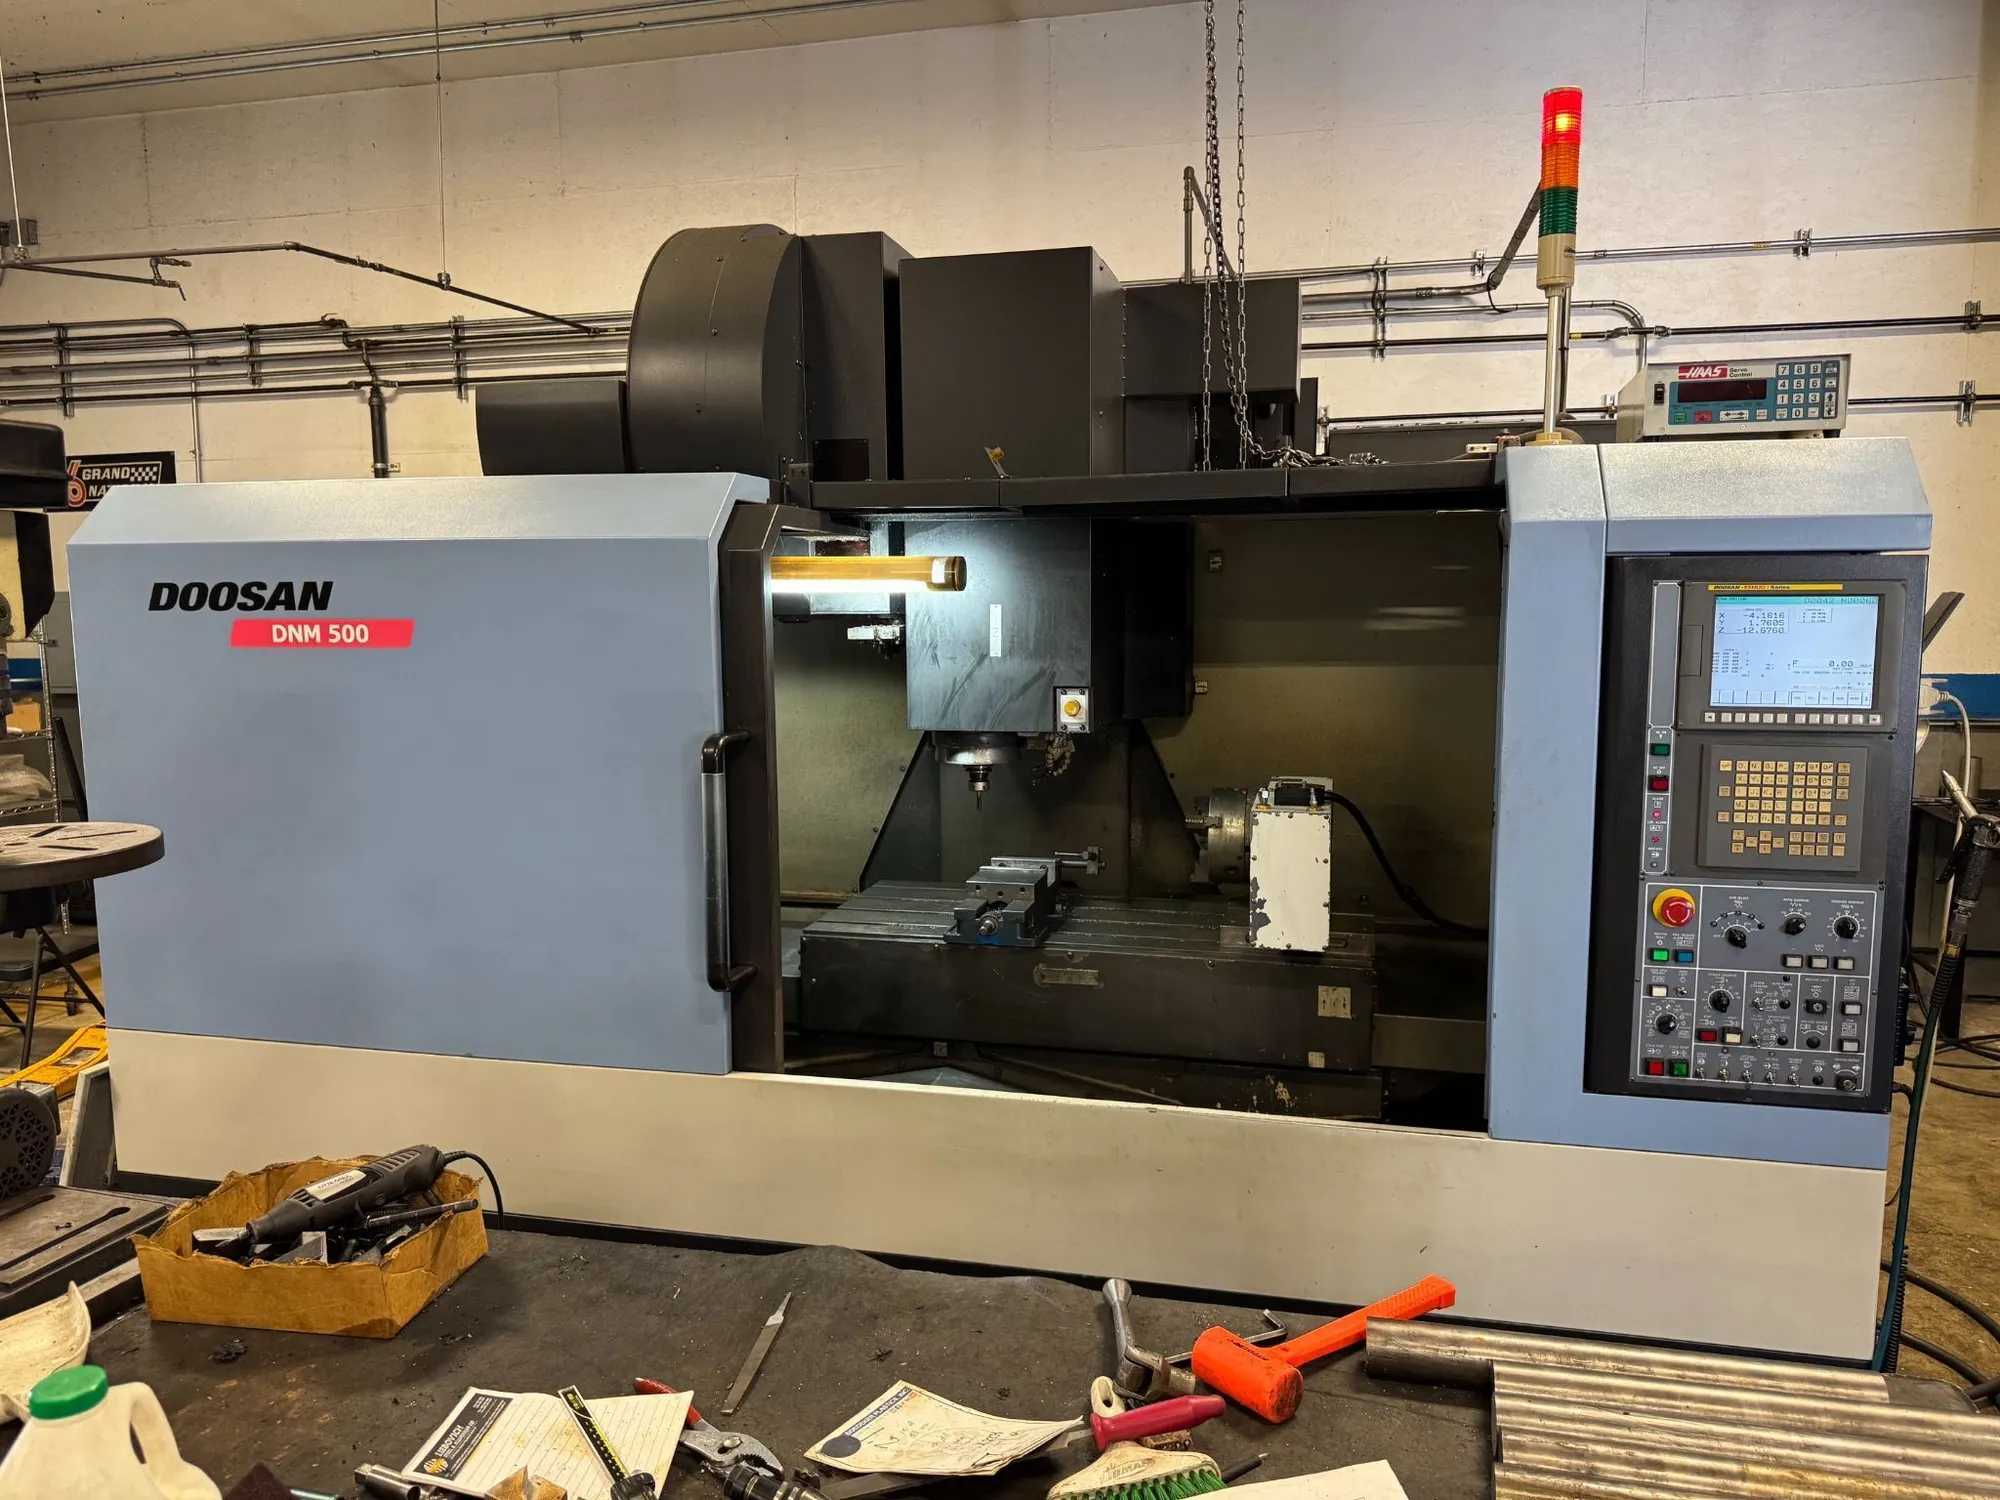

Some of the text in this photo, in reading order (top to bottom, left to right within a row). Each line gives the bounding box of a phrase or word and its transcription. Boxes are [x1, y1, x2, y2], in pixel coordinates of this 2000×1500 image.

[1684, 366, 1723, 379] HAAS
[1780, 364, 1819, 375] 7 8 9
[1779, 379, 1818, 388] 4 5 6
[1795, 394, 1802, 403] 2
[1810, 394, 1817, 402] 3
[1794, 408, 1801, 417] 0
[82, 466, 131, 481] GRAND
[148, 581, 334, 612] DOOSAN
[271, 623, 369, 644] DNM 500
